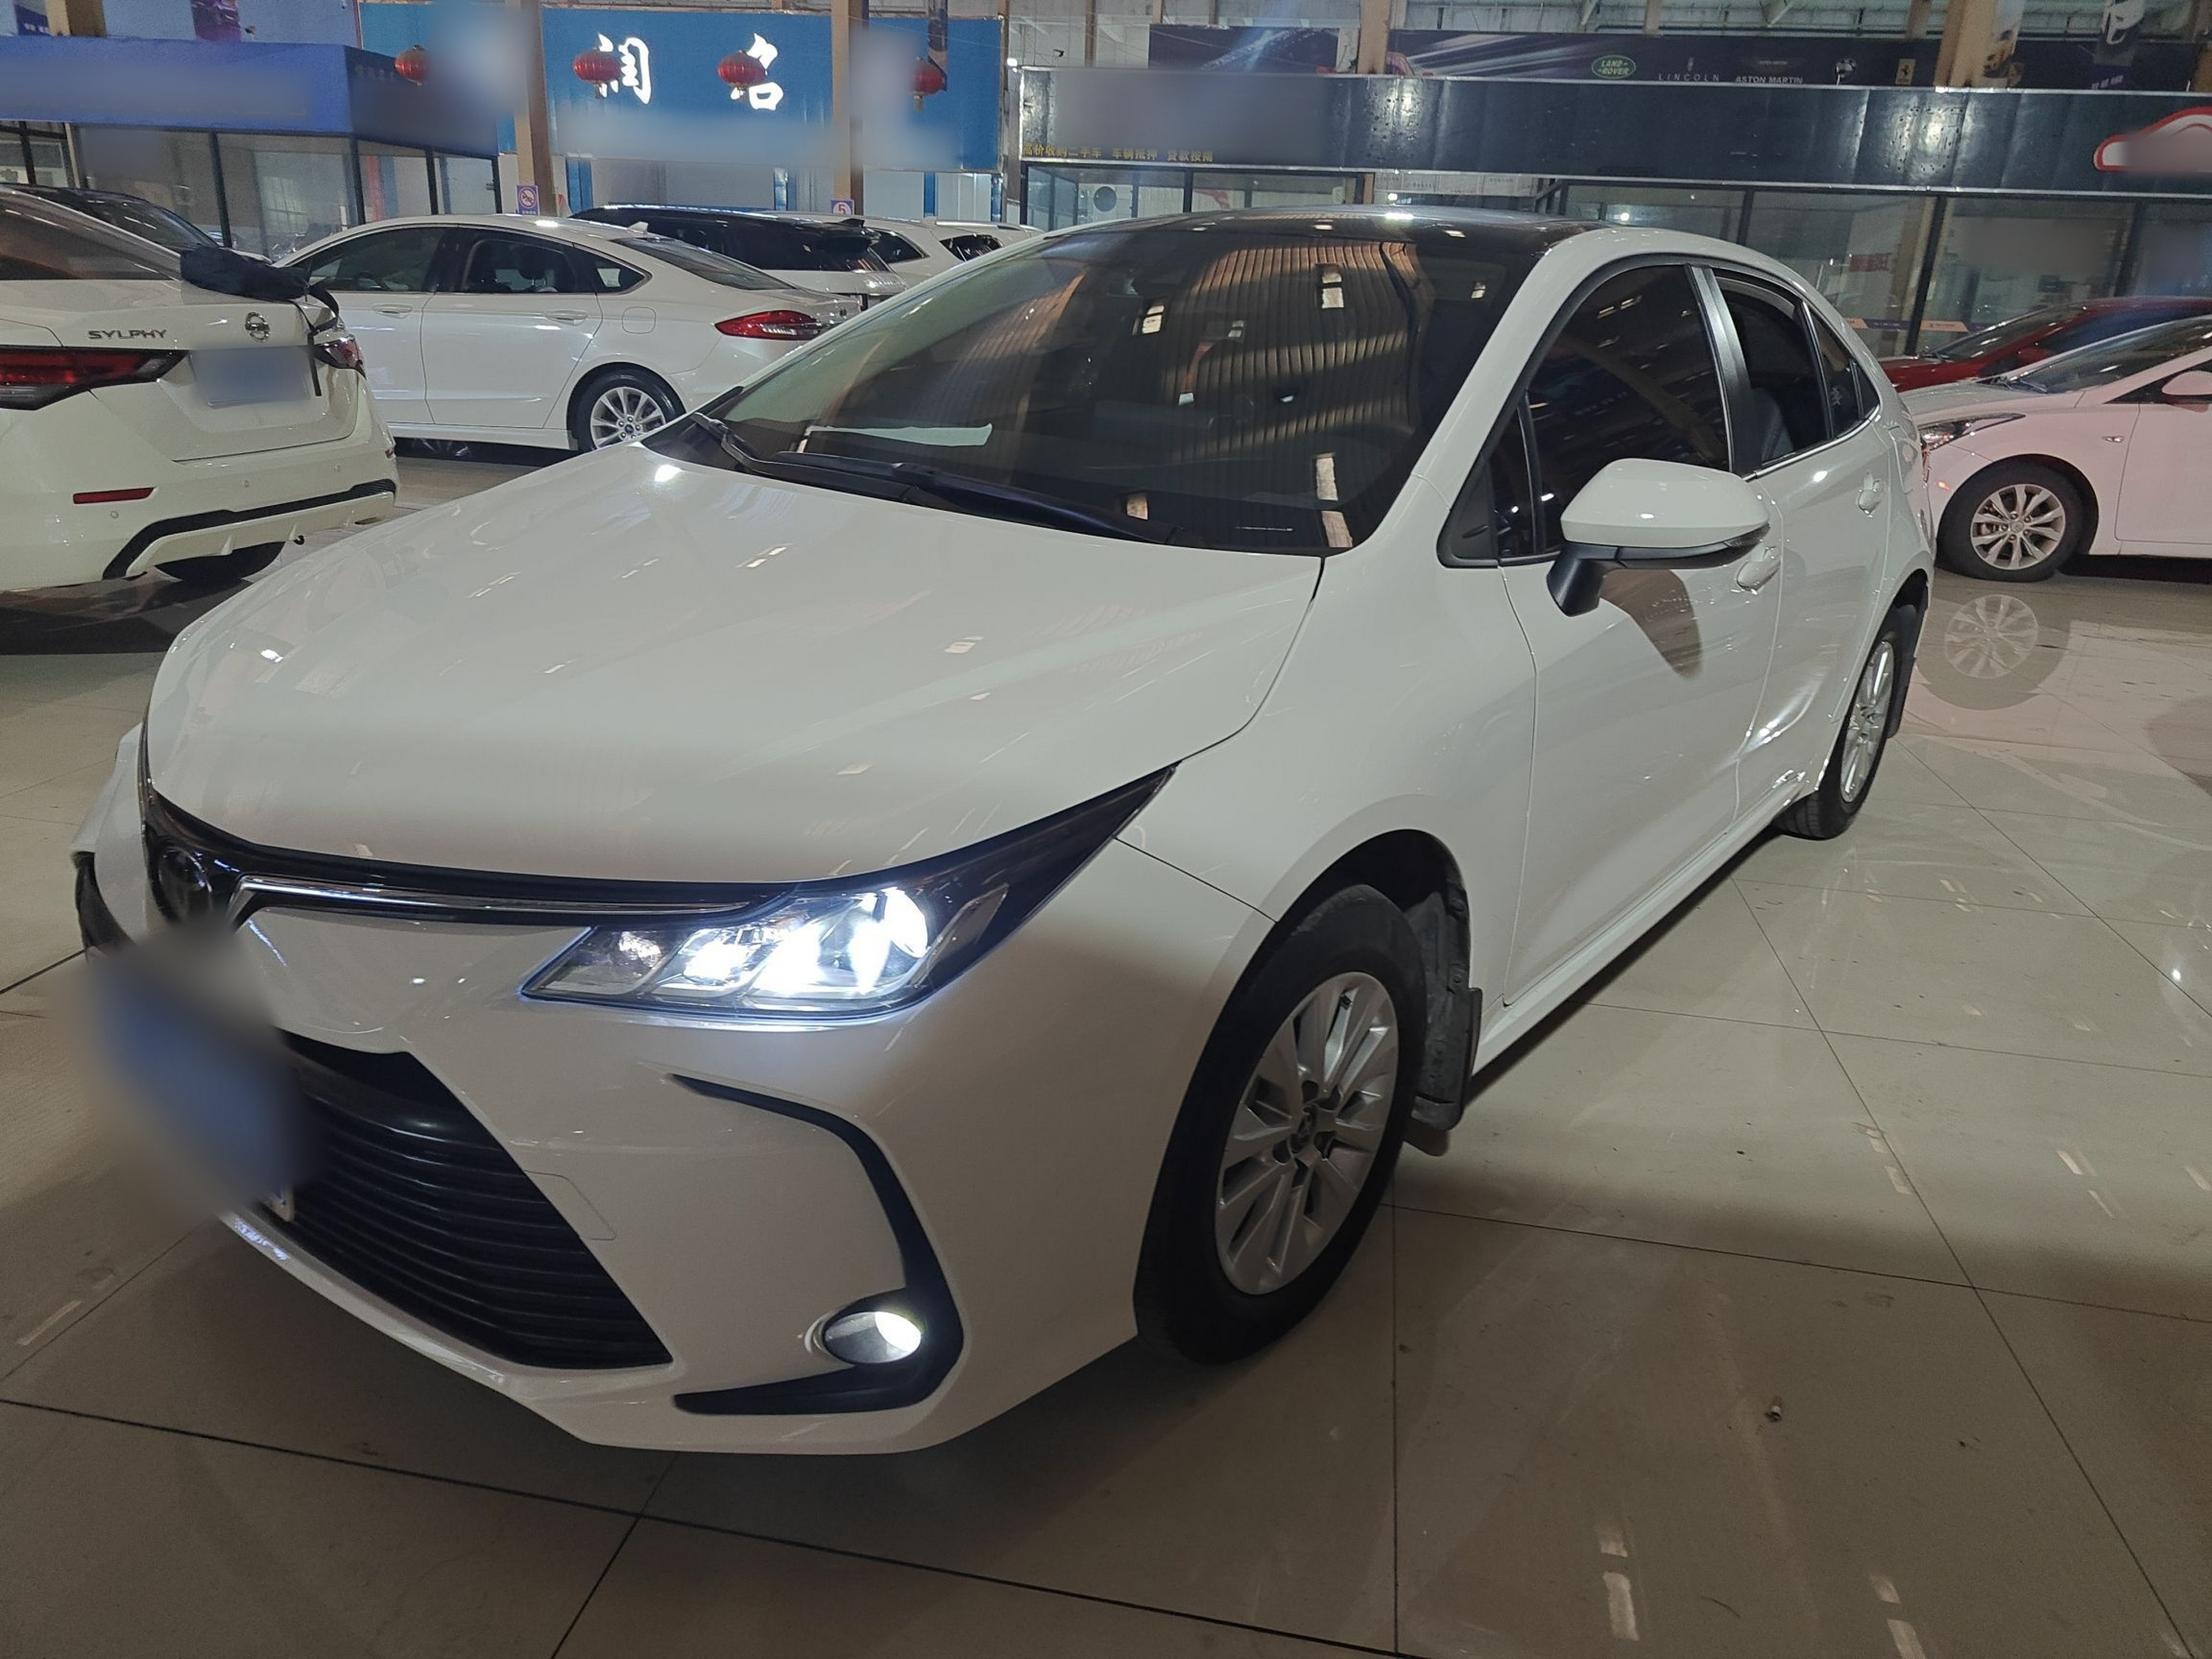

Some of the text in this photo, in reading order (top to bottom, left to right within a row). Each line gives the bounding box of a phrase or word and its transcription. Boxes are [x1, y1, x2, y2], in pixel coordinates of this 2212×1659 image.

[1658, 73, 1720, 82] LINCOLN
[1768, 77, 1803, 85] MARTIN
[1112, 147, 1158, 161] 车辆抵押
[87, 329, 167, 339] SYLPHY
